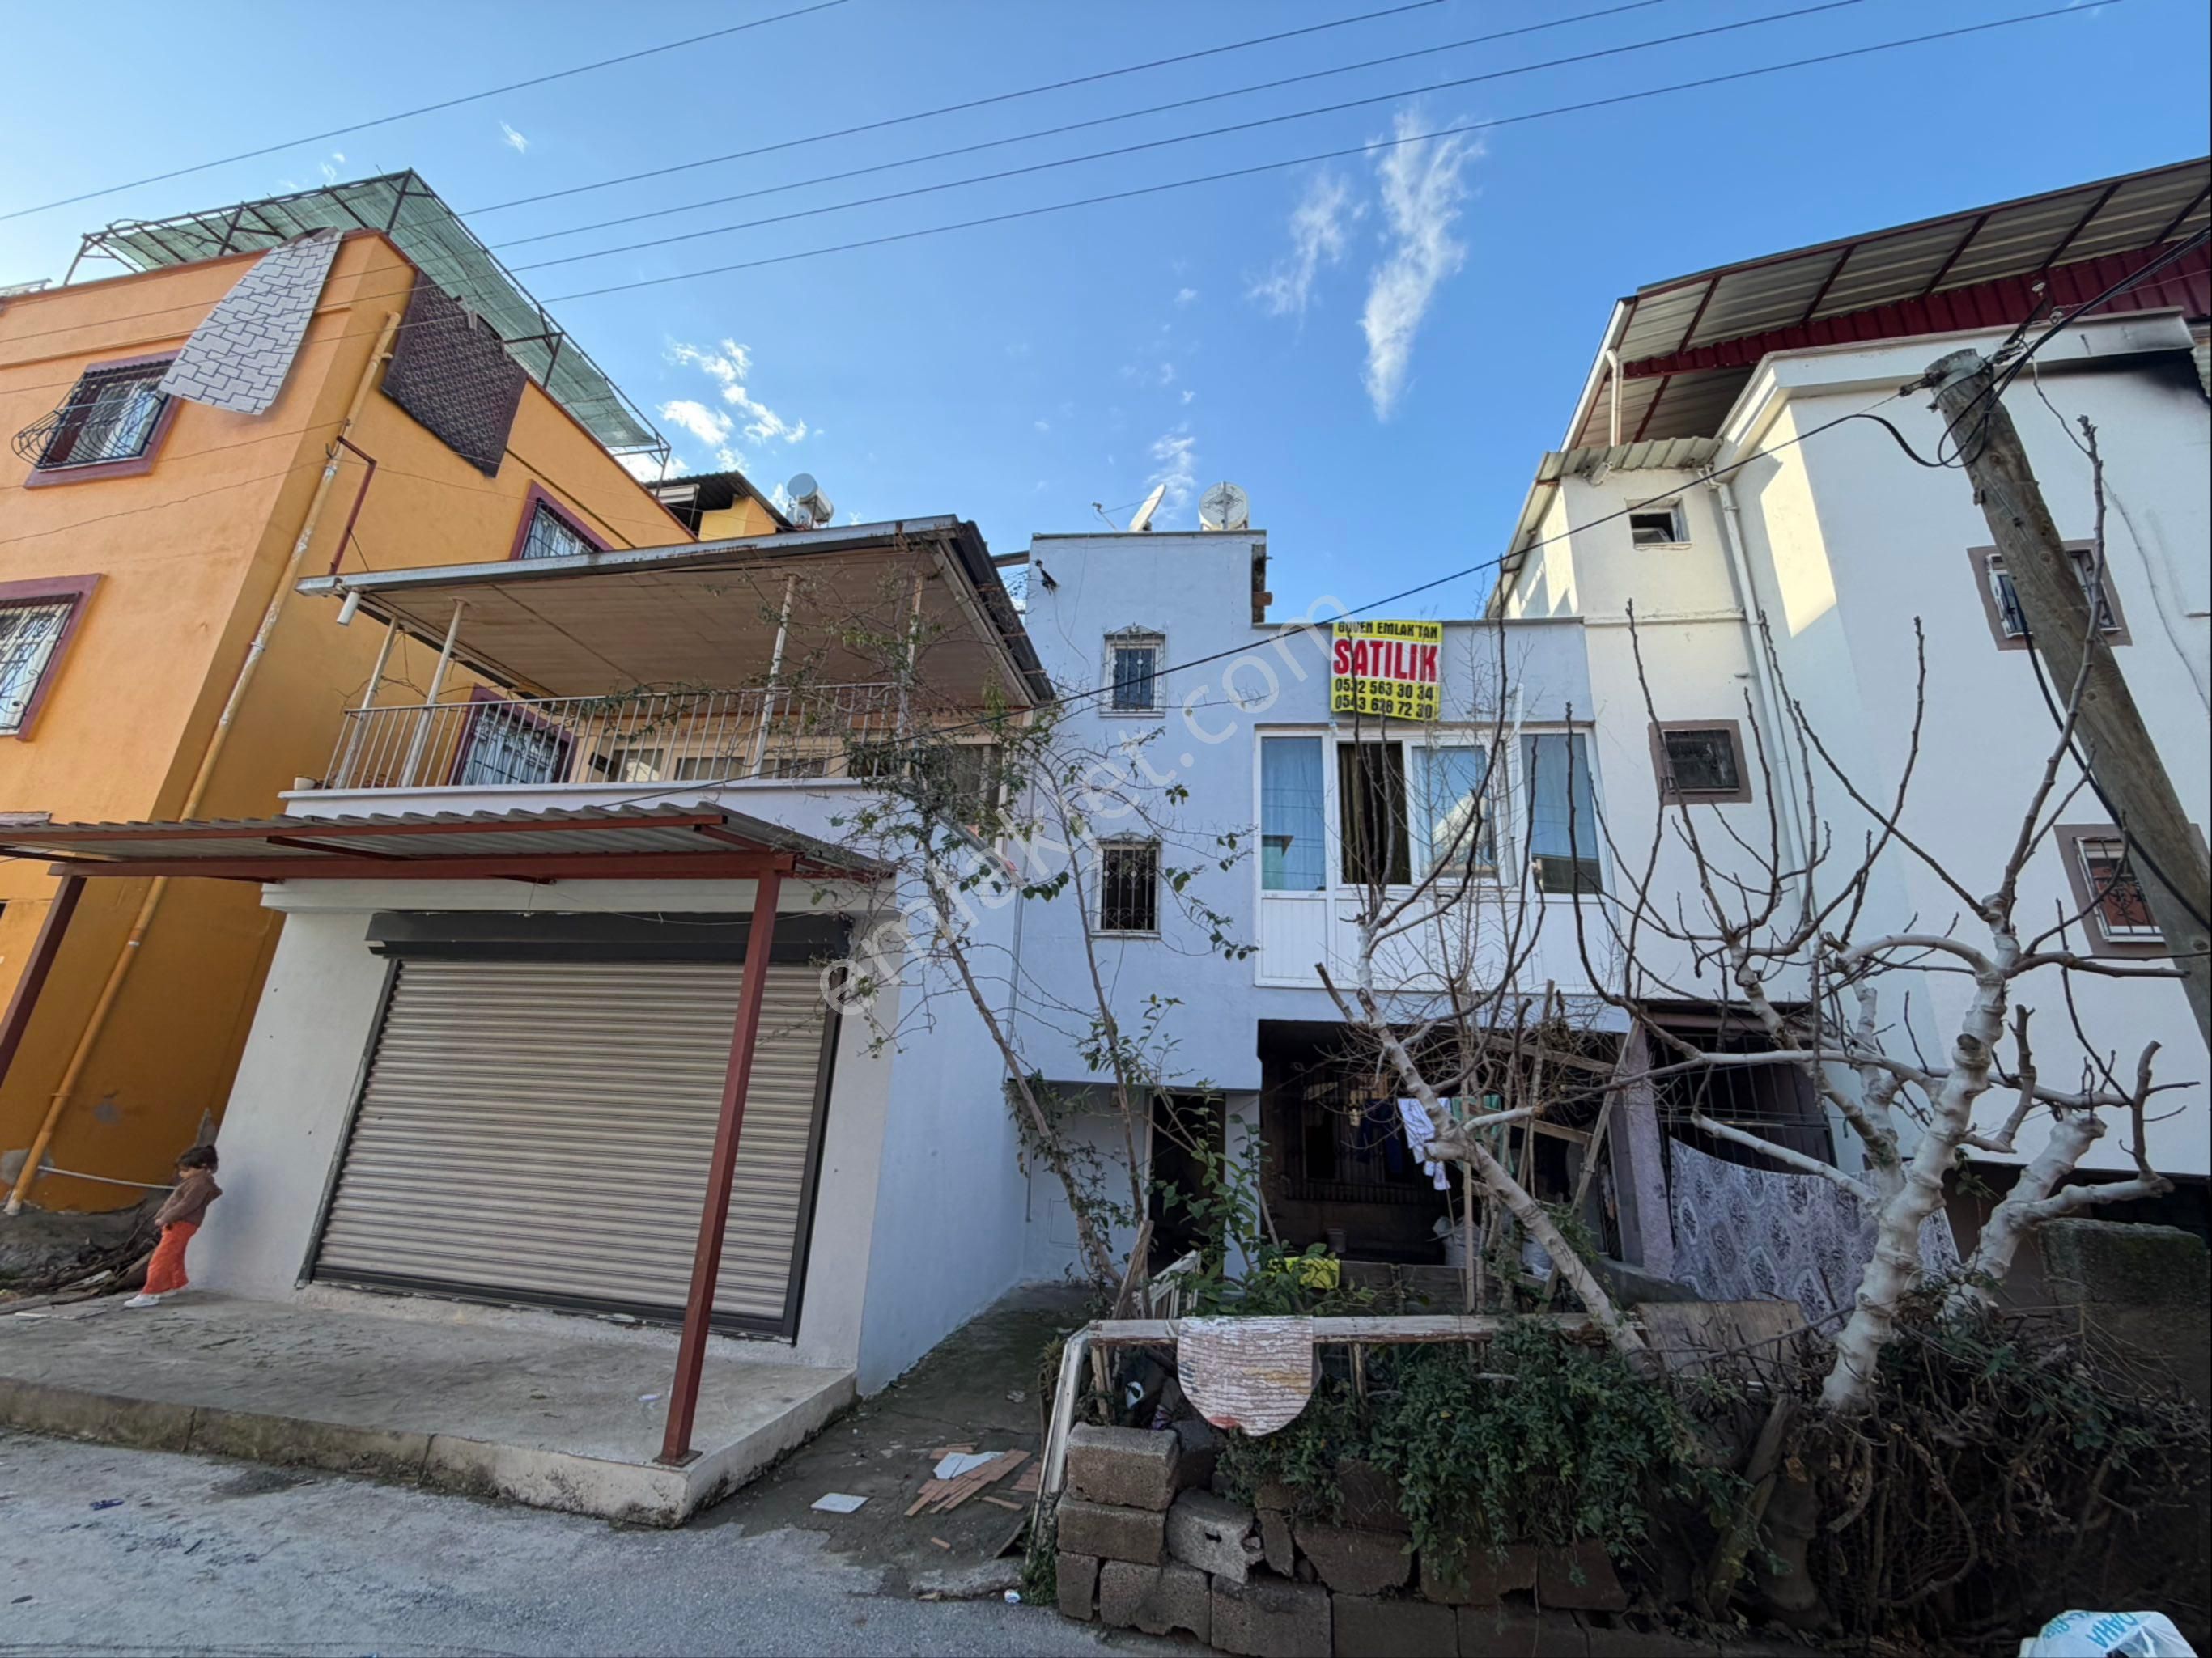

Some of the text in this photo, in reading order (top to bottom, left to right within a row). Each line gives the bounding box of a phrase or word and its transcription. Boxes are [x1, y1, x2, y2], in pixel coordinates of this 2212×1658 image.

[1333, 638, 1437, 682] SATILIK
[1370, 681, 1392, 696] 563
[1397, 684, 1412, 698] 30
[1417, 685, 1433, 701] 34
[1398, 701, 1412, 716] 72
